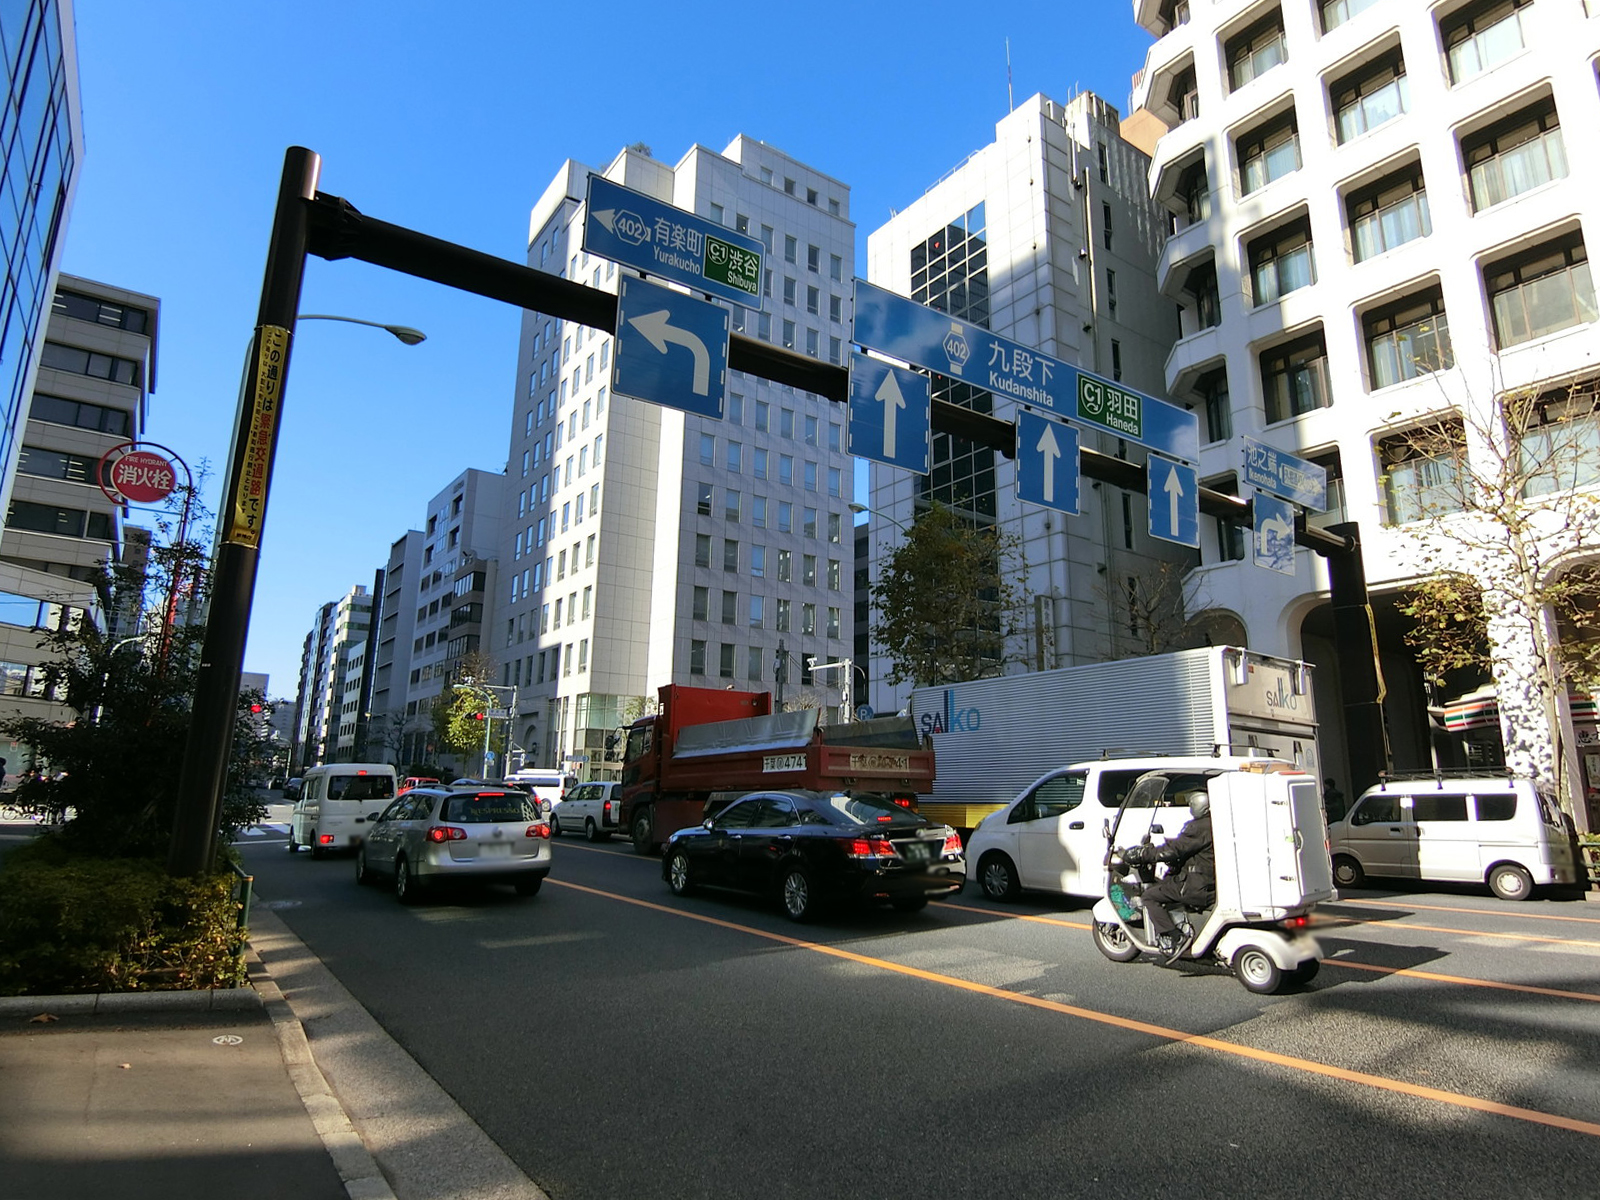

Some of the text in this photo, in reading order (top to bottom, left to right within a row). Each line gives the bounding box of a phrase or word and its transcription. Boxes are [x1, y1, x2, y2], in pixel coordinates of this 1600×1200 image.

[617, 217, 642, 239] 402
[653, 217, 703, 258] 有楽町
[653, 245, 701, 275] Yurakucho
[709, 243, 726, 259] C1
[728, 248, 758, 278] 渋谷
[727, 270, 757, 292] Shibuya
[946, 339, 967, 360] 402
[988, 340, 1055, 386] 九段下
[989, 370, 1054, 408] Kudanshita
[1083, 383, 1101, 405] C1
[1106, 388, 1138, 421] 羽田
[1106, 411, 1139, 435] Haneda
[125, 455, 168, 468] FIRE HYDRANT
[1247, 442, 1277, 475] 池之端
[117, 463, 173, 491] 消火栓
